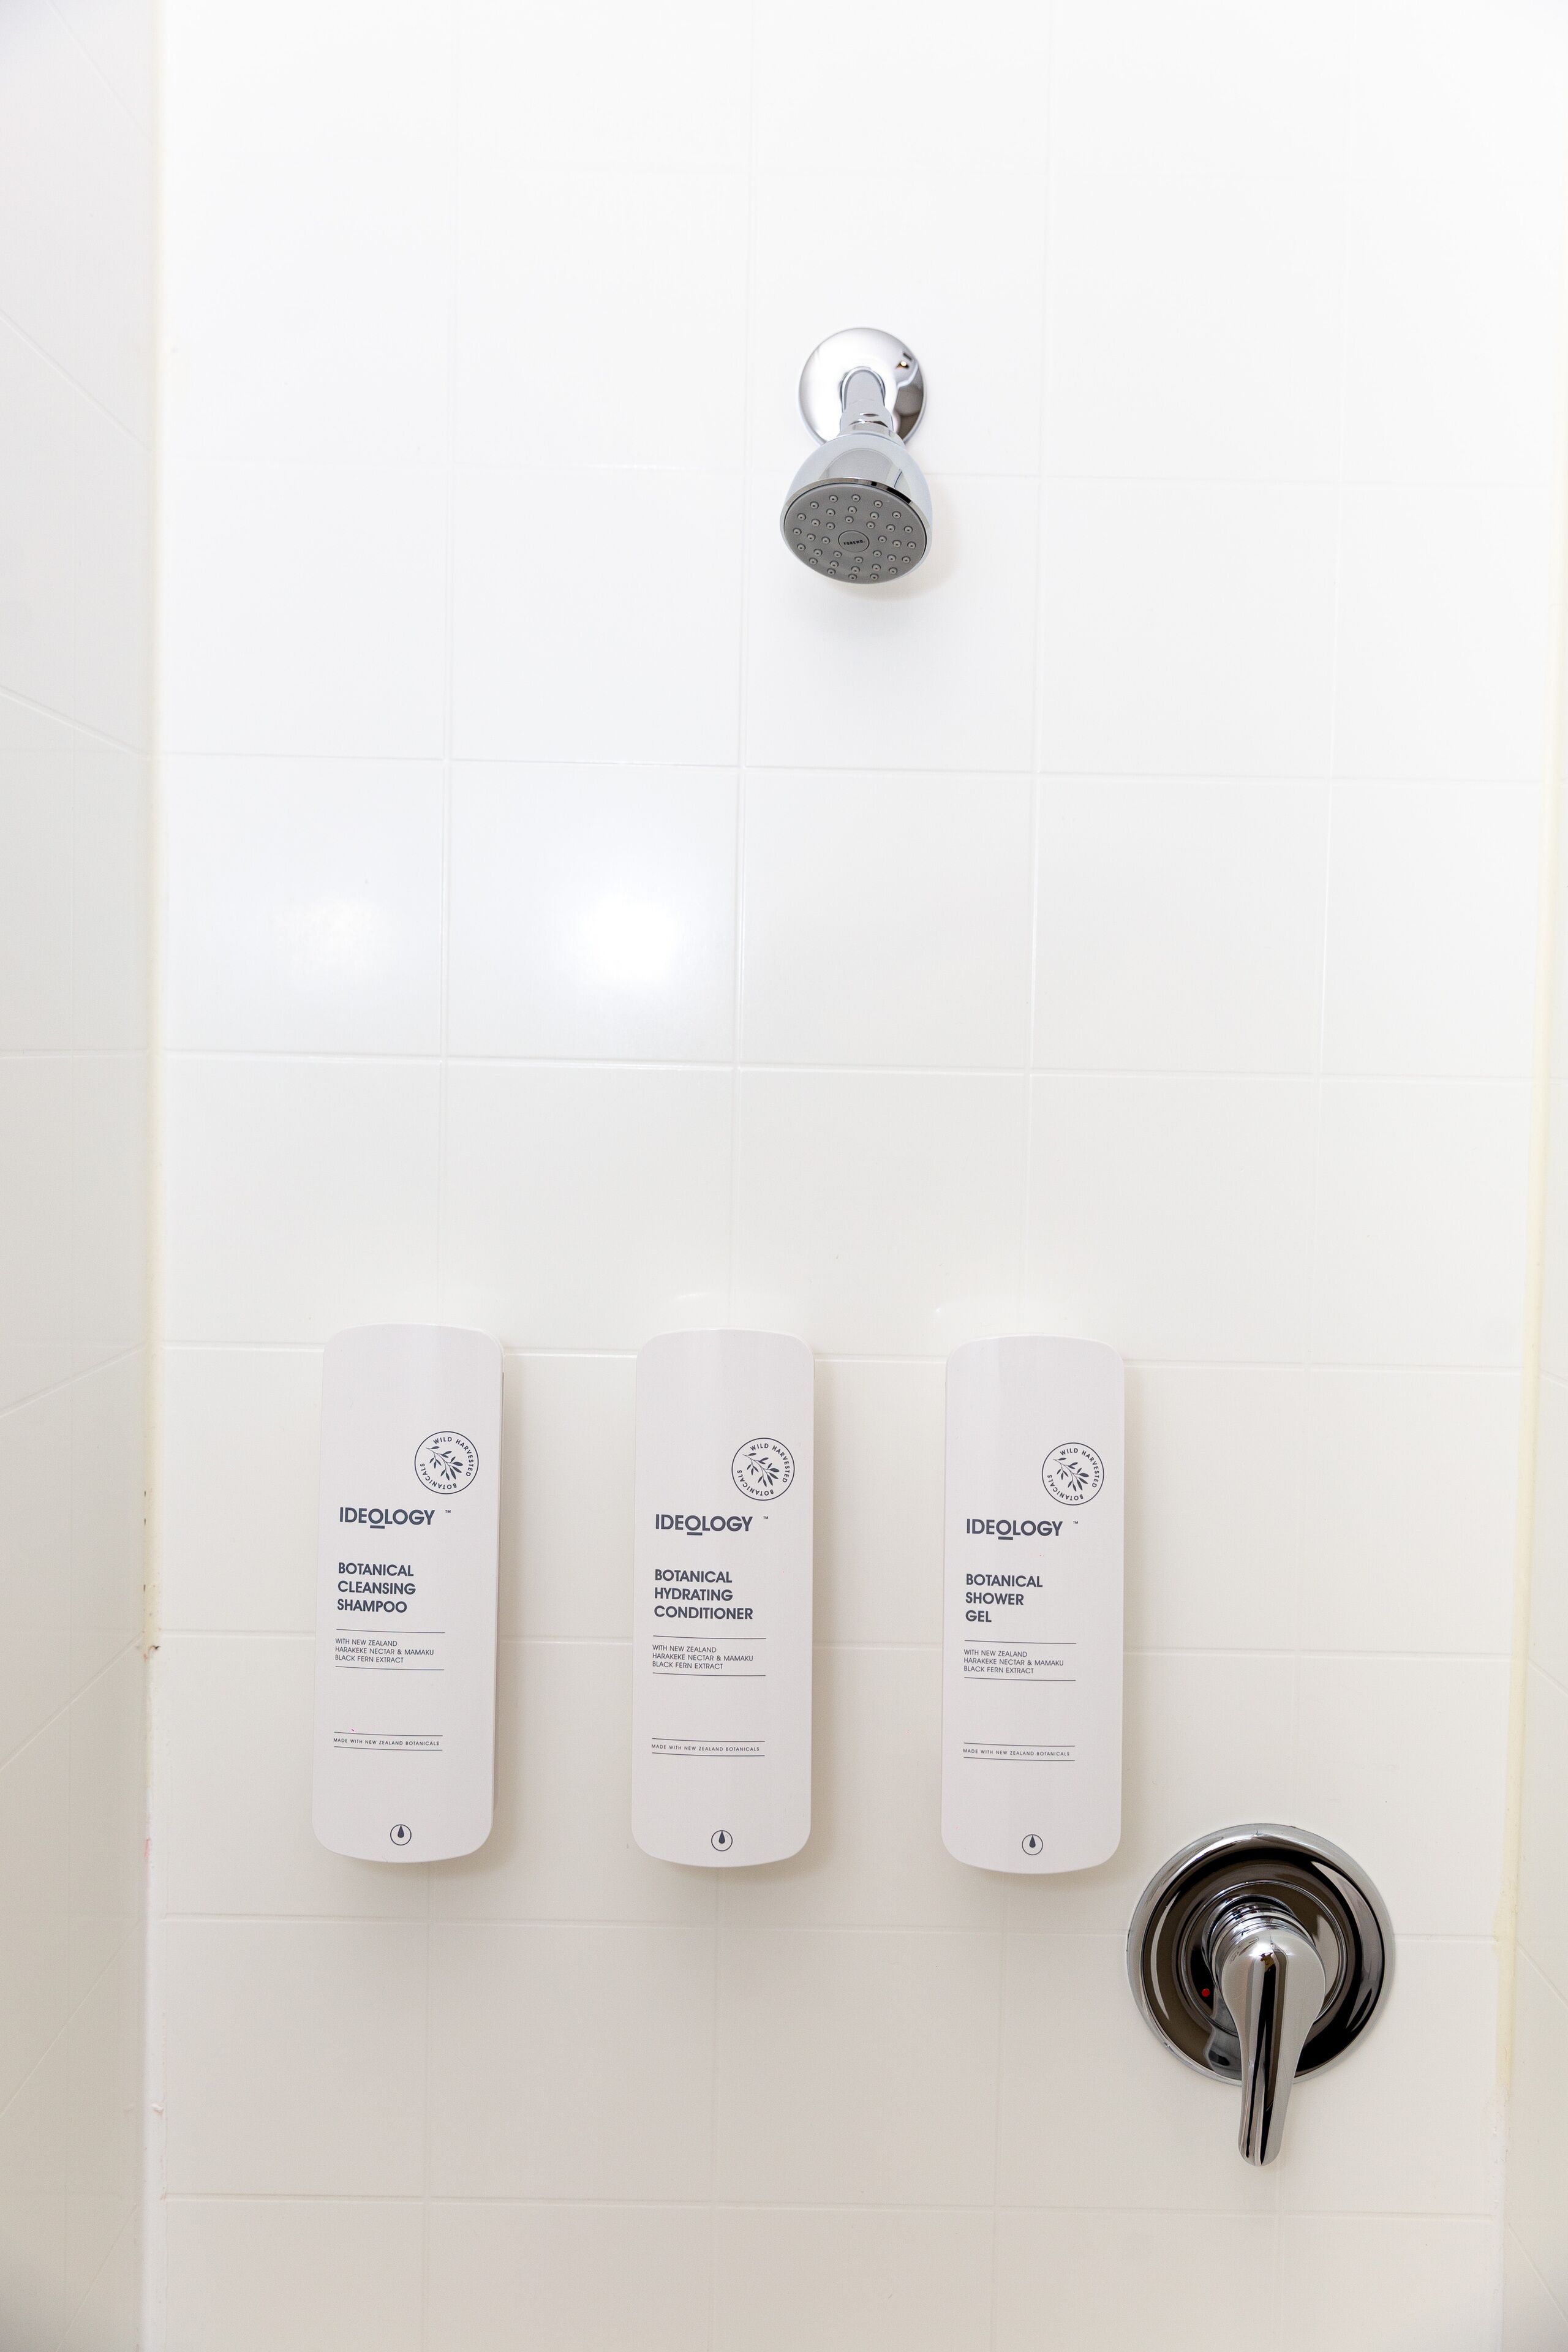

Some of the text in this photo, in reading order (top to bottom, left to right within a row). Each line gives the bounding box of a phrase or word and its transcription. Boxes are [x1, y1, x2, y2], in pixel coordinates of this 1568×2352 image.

[433, 1436, 474, 1477] WILD HARVESTED
[772, 1446, 790, 1483] HARVESTED
[420, 1463, 458, 1490] BOTANICALS
[1060, 1447, 1099, 1488] WILD HARVESTED
[737, 1469, 774, 1496] BOTANICALS
[1047, 1474, 1084, 1501] BOTANICALS
[339, 1507, 435, 1529] IDEOLOGY
[655, 1513, 753, 1536] IDEOLOGY
[967, 1518, 1063, 1540] IDEOLOGY
[339, 1562, 414, 1577] BOTANICAL
[655, 1569, 733, 1583] BOTANICAL
[337, 1580, 416, 1595] CLEANSING
[966, 1574, 1043, 1588] BOTANICAL
[654, 1587, 733, 1601] HYDRATING
[965, 1591, 1024, 1605] SHOWER
[337, 1599, 407, 1613] SHAMPOO
[654, 1605, 753, 1619] CONDITIONER
[965, 1610, 992, 1623] GEL
